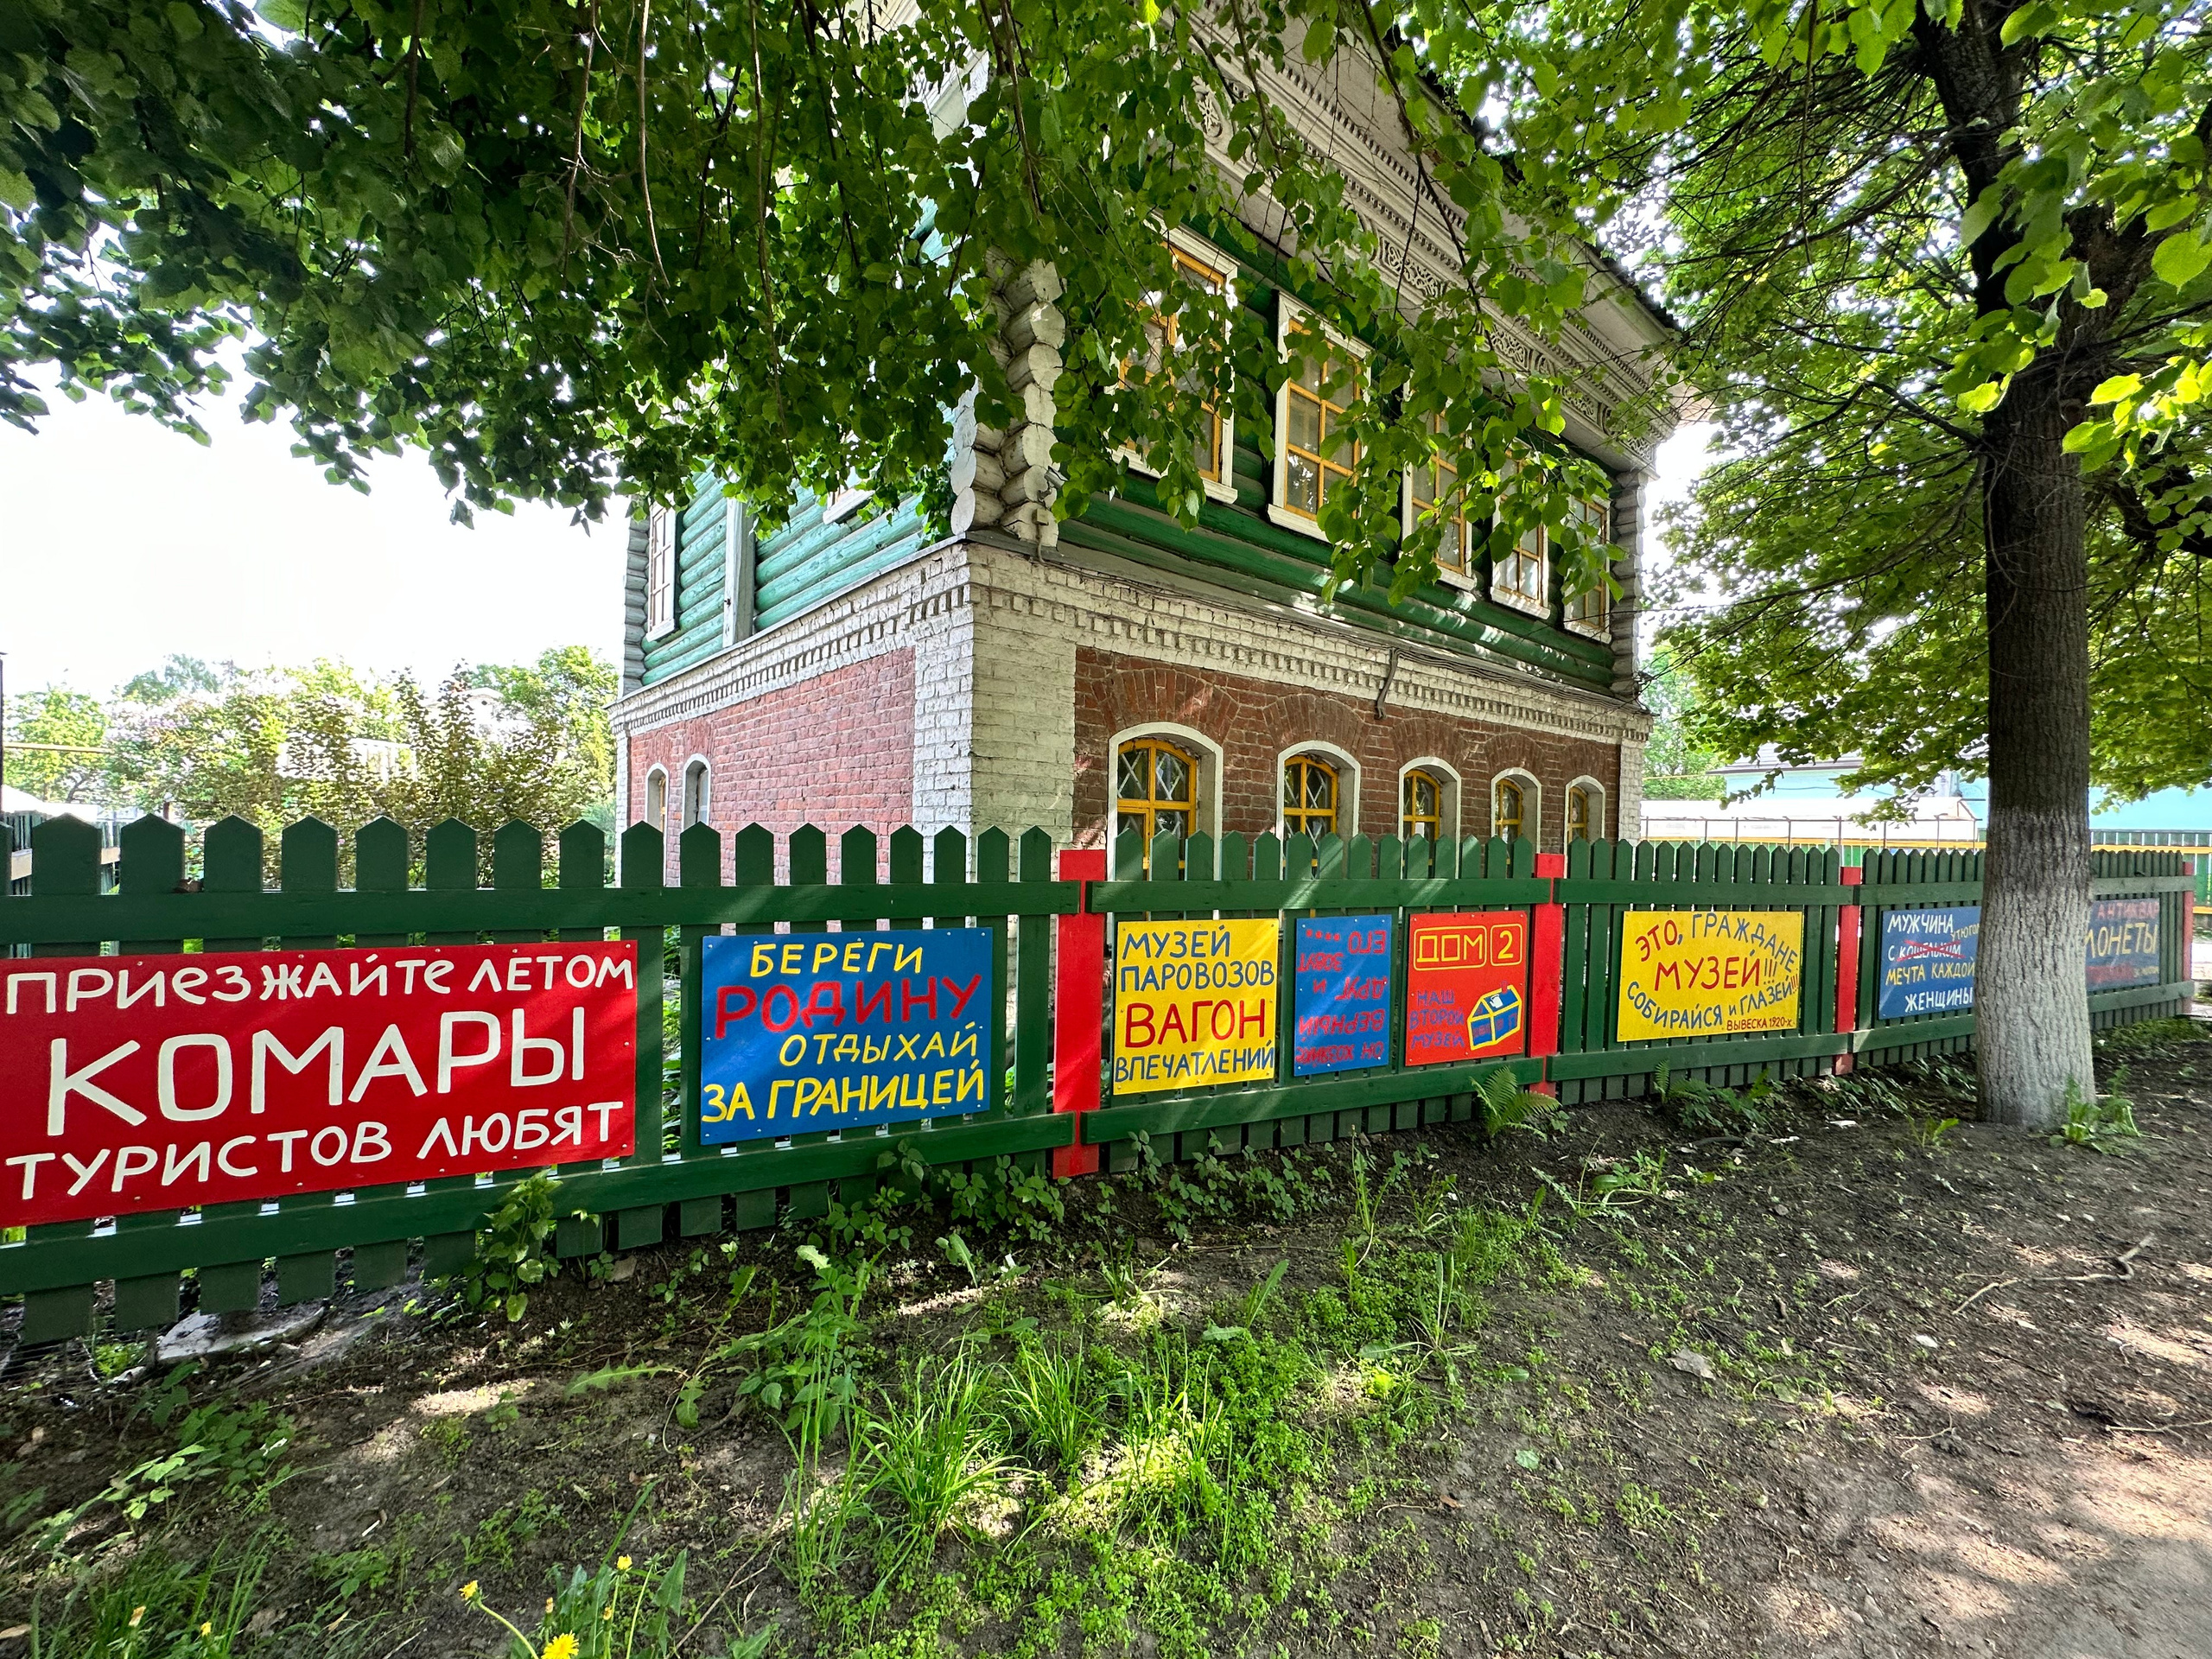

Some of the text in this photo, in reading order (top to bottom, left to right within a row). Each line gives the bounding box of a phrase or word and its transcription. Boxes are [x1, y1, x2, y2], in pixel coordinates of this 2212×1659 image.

[1887, 913, 1954, 935] МУЖЧИНА
[1122, 925, 1230, 960] МУЗЕЙ
[1348, 930, 1387, 955] ЕГО
[1416, 930, 1514, 963] ДОМ 2
[1691, 912, 1798, 973] ГРАЖДАНЕ
[1888, 944, 1895, 962] С
[467, 954, 633, 994] ЛЕТОМ
[750, 942, 923, 977] БЕРЕГИ
[1121, 960, 1274, 992] ПАРОВОЗОВ
[1297, 952, 1344, 973] ЗОВУТ
[1654, 949, 1777, 992] МУЗЕЙ!!!
[1885, 957, 1975, 986] МЕЧТА КАЖДОЙ
[1335, 976, 1388, 1001] ДРУГ
[1417, 989, 1455, 1007] НАШ
[1904, 987, 1974, 1013] ЖЕНЩИНЫ
[715, 974, 982, 1039] РОДИНУ
[1409, 1007, 1465, 1030] ВТОРОЙ
[1627, 981, 1723, 1030] СОБИРАЙСЯ
[1125, 999, 1265, 1047] ВАГОН
[1299, 1008, 1385, 1042] ВЕРНЫЙ
[1726, 1018, 1768, 1031] ВЫВЕСКА
[779, 1021, 978, 1066] ОТДЫХАЙ
[1360, 1041, 1383, 1061] ОН
[1411, 1030, 1465, 1050] МУЗЕЙ
[48, 1007, 585, 1136] КОМАРЫ
[1115, 1039, 1274, 1083] ВПЕЧАТЛЕНИЙ
[702, 1059, 984, 1122] ЗА ГРАНИЦЕЙ
[6, 1100, 624, 1200] ТУРИСТОВ ЛЮБЯТ
